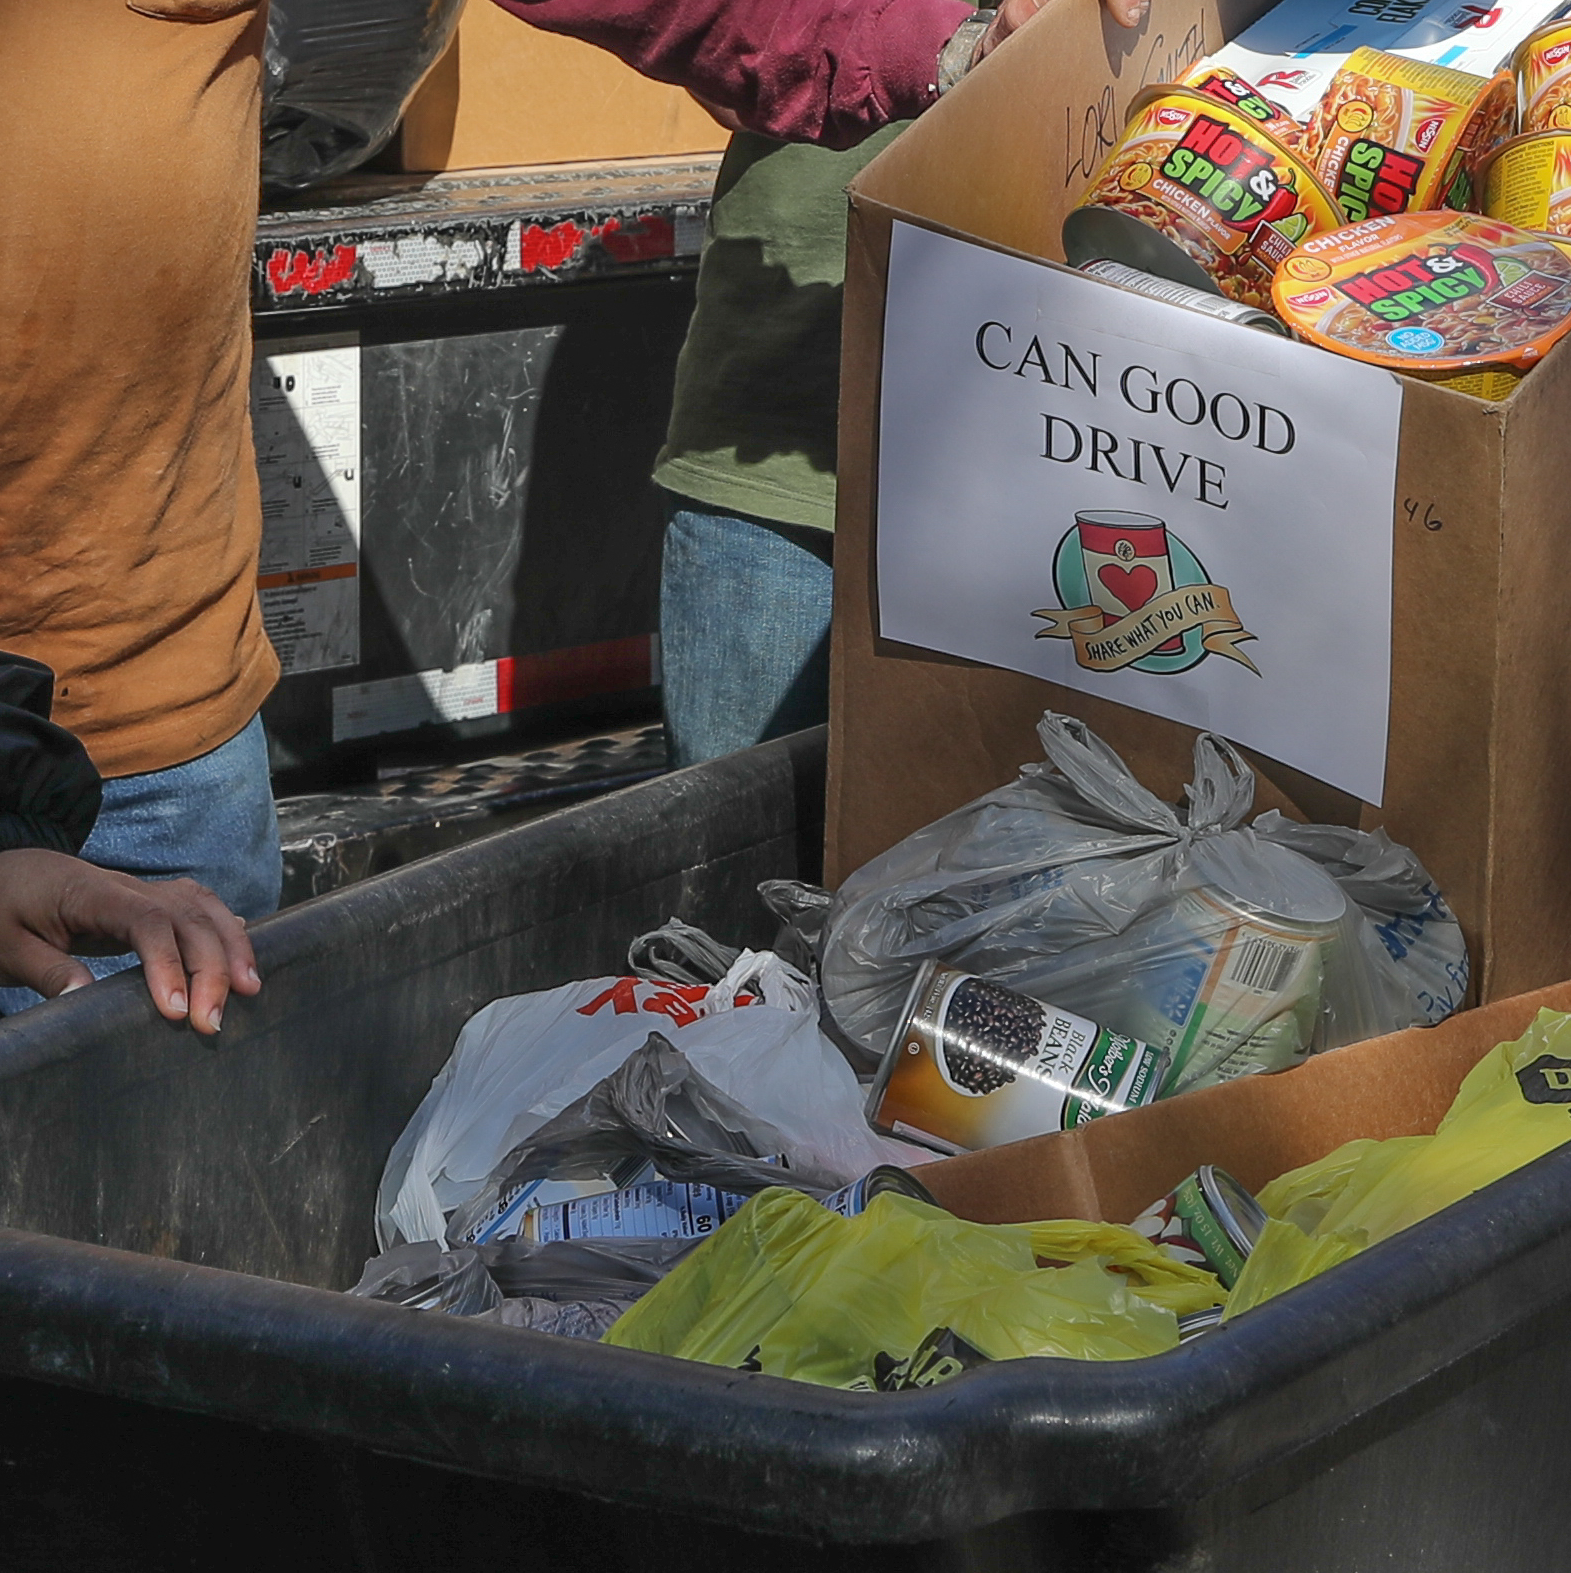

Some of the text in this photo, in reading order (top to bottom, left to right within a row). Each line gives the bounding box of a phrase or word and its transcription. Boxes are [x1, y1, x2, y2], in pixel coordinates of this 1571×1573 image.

[1544, 45, 1571, 61] NISSIN
[1065, 84, 1118, 188] LORI
[1159, 108, 1188, 123] NISSIN
[1418, 119, 1440, 150] NISSIN
[1180, 118, 1269, 180] HOT
[1249, 168, 1277, 202] &
[1322, 135, 1351, 194] CHICKE
[1337, 141, 1385, 224] SPIC
[1163, 149, 1264, 222] SPICY
[1369, 151, 1421, 219] HO
[1152, 178, 1232, 241] CHICKEN FLAVOR
[1260, 240, 1285, 263] SAUC
[1303, 215, 1397, 255] CHICKEN
[1339, 233, 1381, 254] FLAVOR
[1294, 291, 1326, 305] NISSIN
[1340, 255, 1464, 307] HOT &
[1369, 267, 1486, 322] SPICY
[1506, 279, 1533, 300] CHILI
[1512, 282, 1547, 306] SAUCE
[1397, 331, 1414, 340] NO
[975, 320, 1296, 455] CAN GOOD
[1039, 412, 1230, 510] DRIVE
[1403, 497, 1443, 532] 46
[1084, 591, 1221, 661] SHARE WHAT YOU CAN.
[1037, 1015, 1073, 1081] BEANS
[1059, 1027, 1087, 1075] Black
[1127, 1049, 1155, 1104] LOW SODIUM
[696, 1213, 712, 1234] 60
[1200, 1224, 1213, 1237] 15
[1211, 1237, 1225, 1257] Wt.
